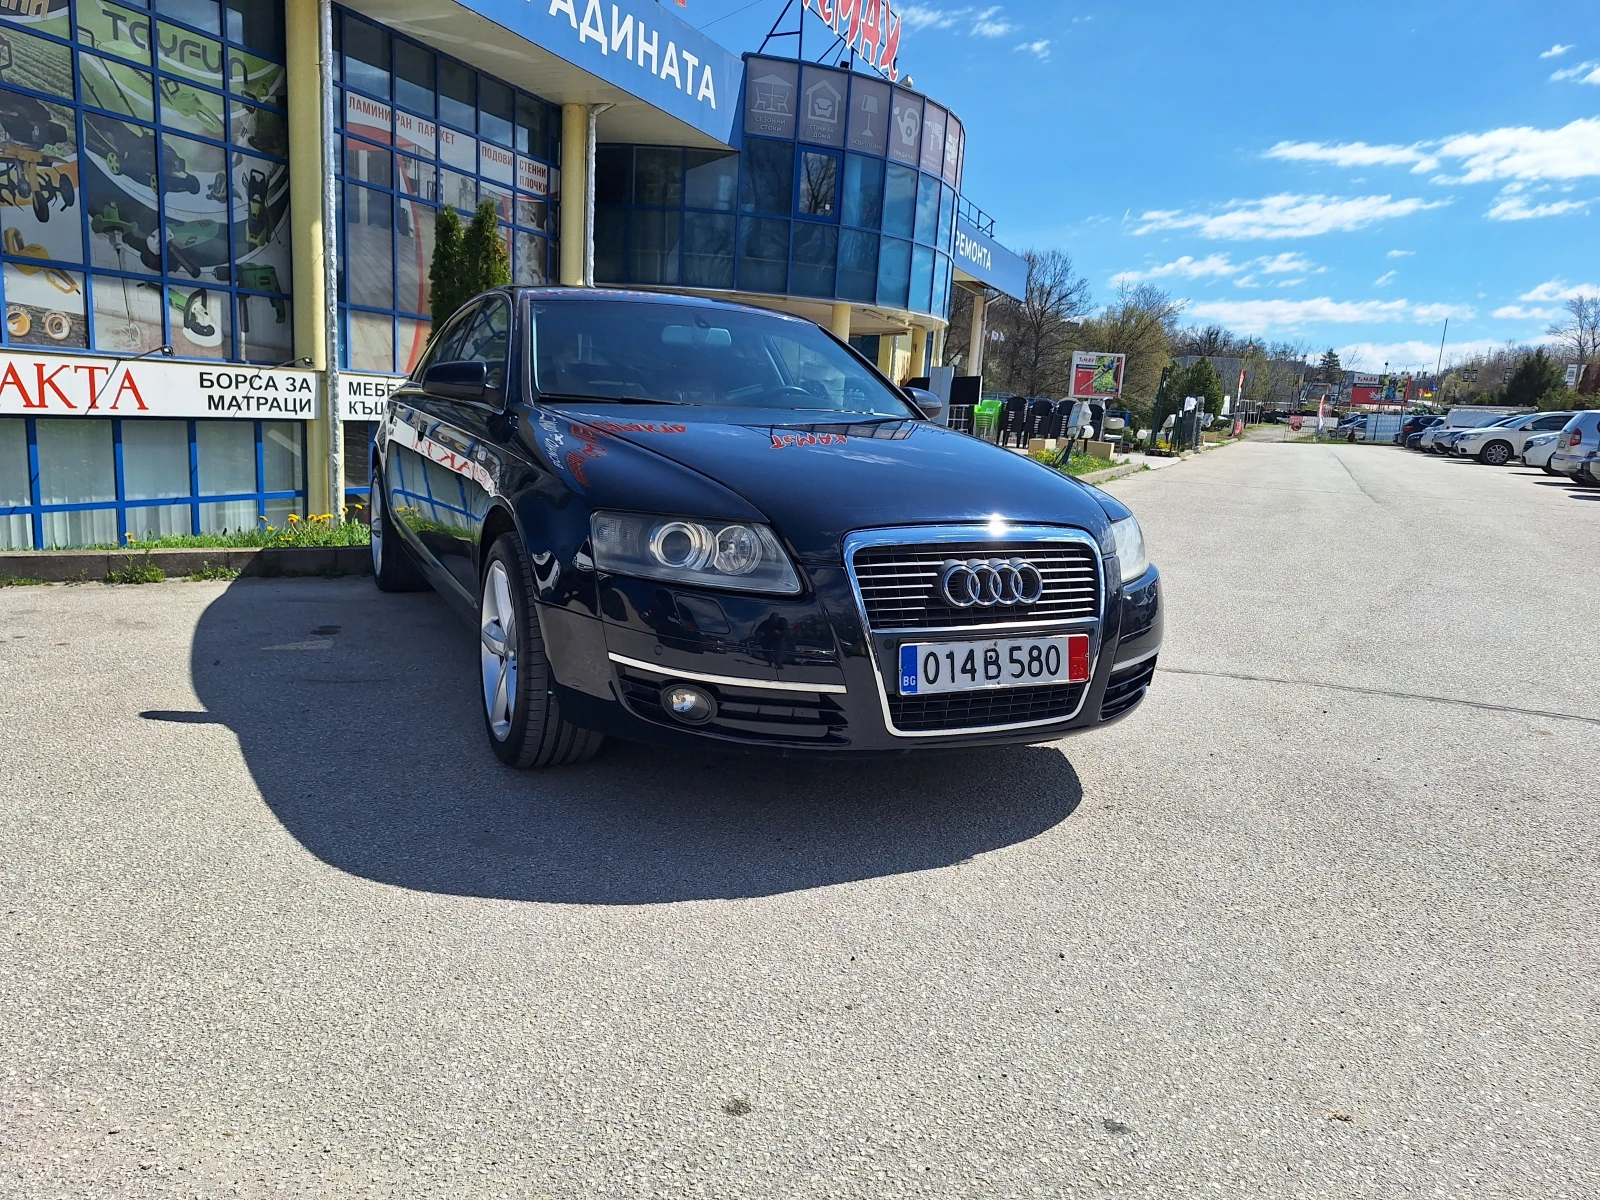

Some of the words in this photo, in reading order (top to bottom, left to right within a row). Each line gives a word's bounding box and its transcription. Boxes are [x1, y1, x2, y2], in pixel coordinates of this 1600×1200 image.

[348, 95, 413, 131] ЛАМИНИРАН
[417, 121, 456, 146] ПАРКЕТ
[755, 116, 787, 126] СЕЗОННИ
[760, 124, 782, 132] СТОКИ
[812, 131, 832, 140] ДОМА
[481, 145, 513, 167] ПОДОВИ
[519, 159, 547, 179] СТЕННИ
[519, 174, 548, 194] ПЛОЧКИ
[199, 371, 279, 393] БОРСА
[285, 376, 313, 393] ЗА
[348, 381, 399, 397] МЕБЕ
[207, 394, 312, 415] МАТРАЦИ
[903, 675, 916, 687] BG
